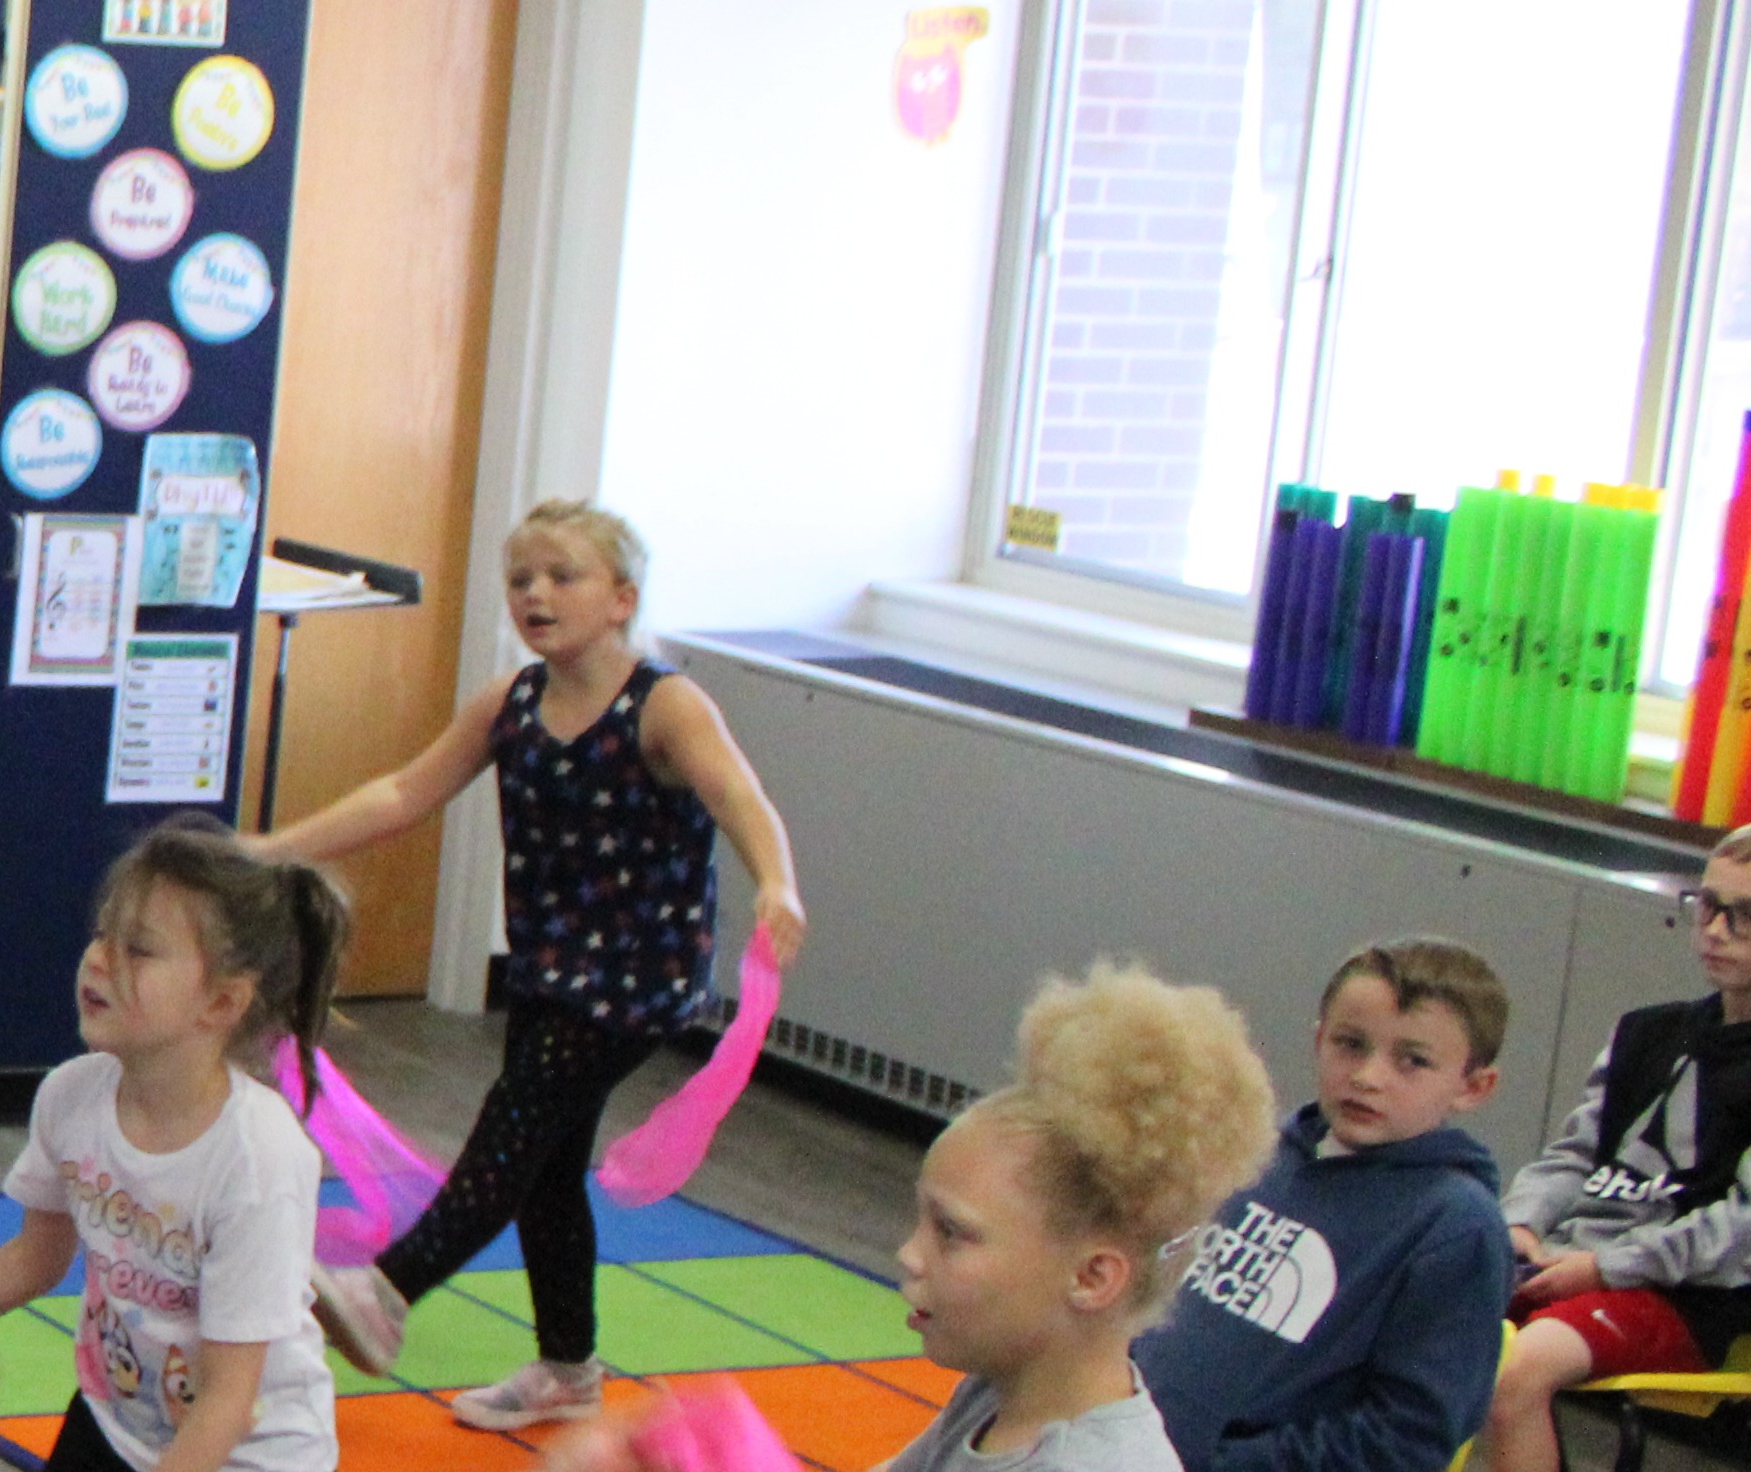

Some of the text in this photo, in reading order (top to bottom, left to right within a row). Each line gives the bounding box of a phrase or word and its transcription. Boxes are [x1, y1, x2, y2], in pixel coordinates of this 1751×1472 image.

[61, 72, 88, 103] Be
[216, 83, 243, 119] Be
[130, 172, 157, 206] Be
[201, 257, 251, 289] Make
[128, 345, 154, 375] Be
[38, 413, 65, 444] Be
[1236, 1201, 1306, 1257] THE
[1195, 1223, 1289, 1288] ORTH
[1180, 1255, 1268, 1317] FACE
